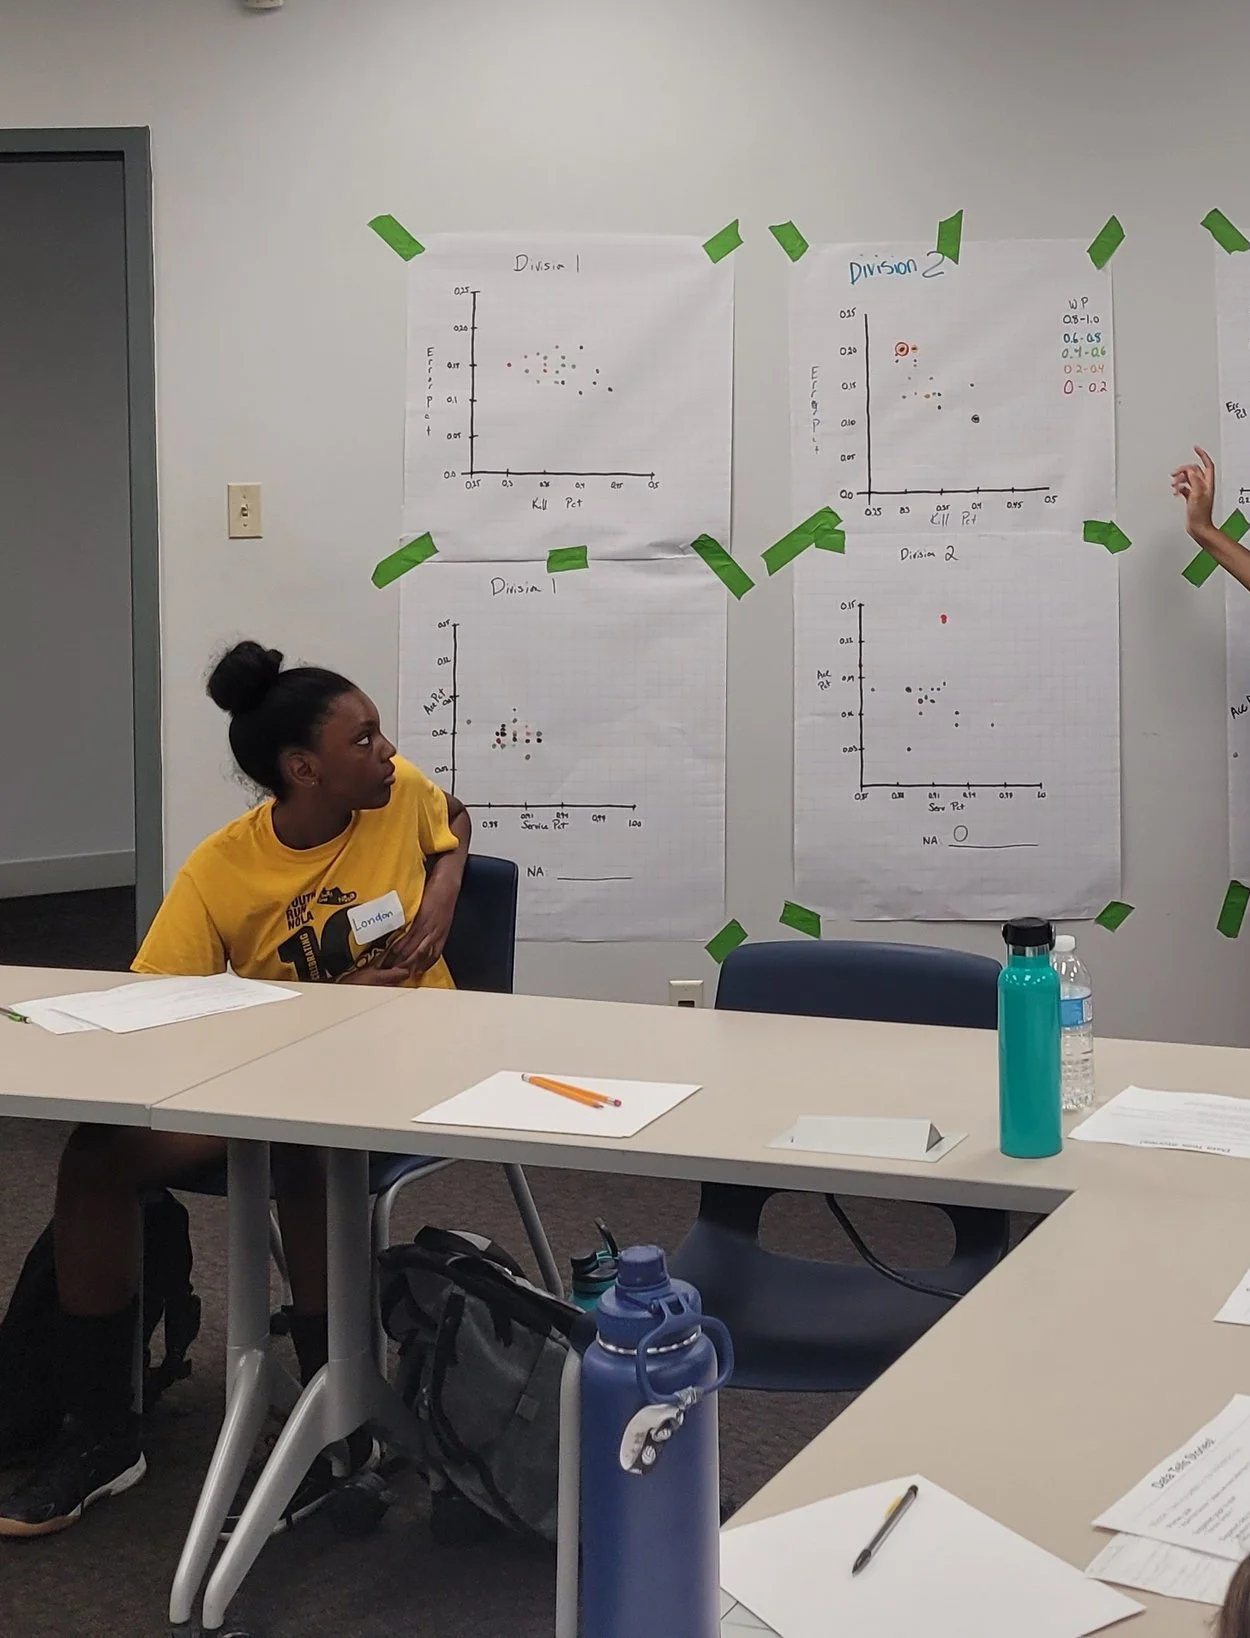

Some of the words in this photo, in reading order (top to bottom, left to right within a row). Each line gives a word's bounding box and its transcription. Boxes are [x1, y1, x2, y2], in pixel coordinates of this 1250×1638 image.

[514, 254, 565, 272] Division
[576, 254, 580, 272] 1
[922, 250, 945, 278] 2
[532, 498, 548, 510] Kill
[566, 497, 583, 508] Pct
[930, 512, 950, 526] Kill
[961, 511, 977, 526] Pct
[944, 545, 959, 561] 2
[552, 578, 556, 594] 1
[950, 802, 966, 812] Pct
[520, 821, 549, 830] Service
[552, 818, 570, 830] Pct
[288, 889, 316, 908] OUTH
[286, 903, 308, 920] RUN
[288, 910, 314, 930] NOLA
[352, 910, 394, 932] London
